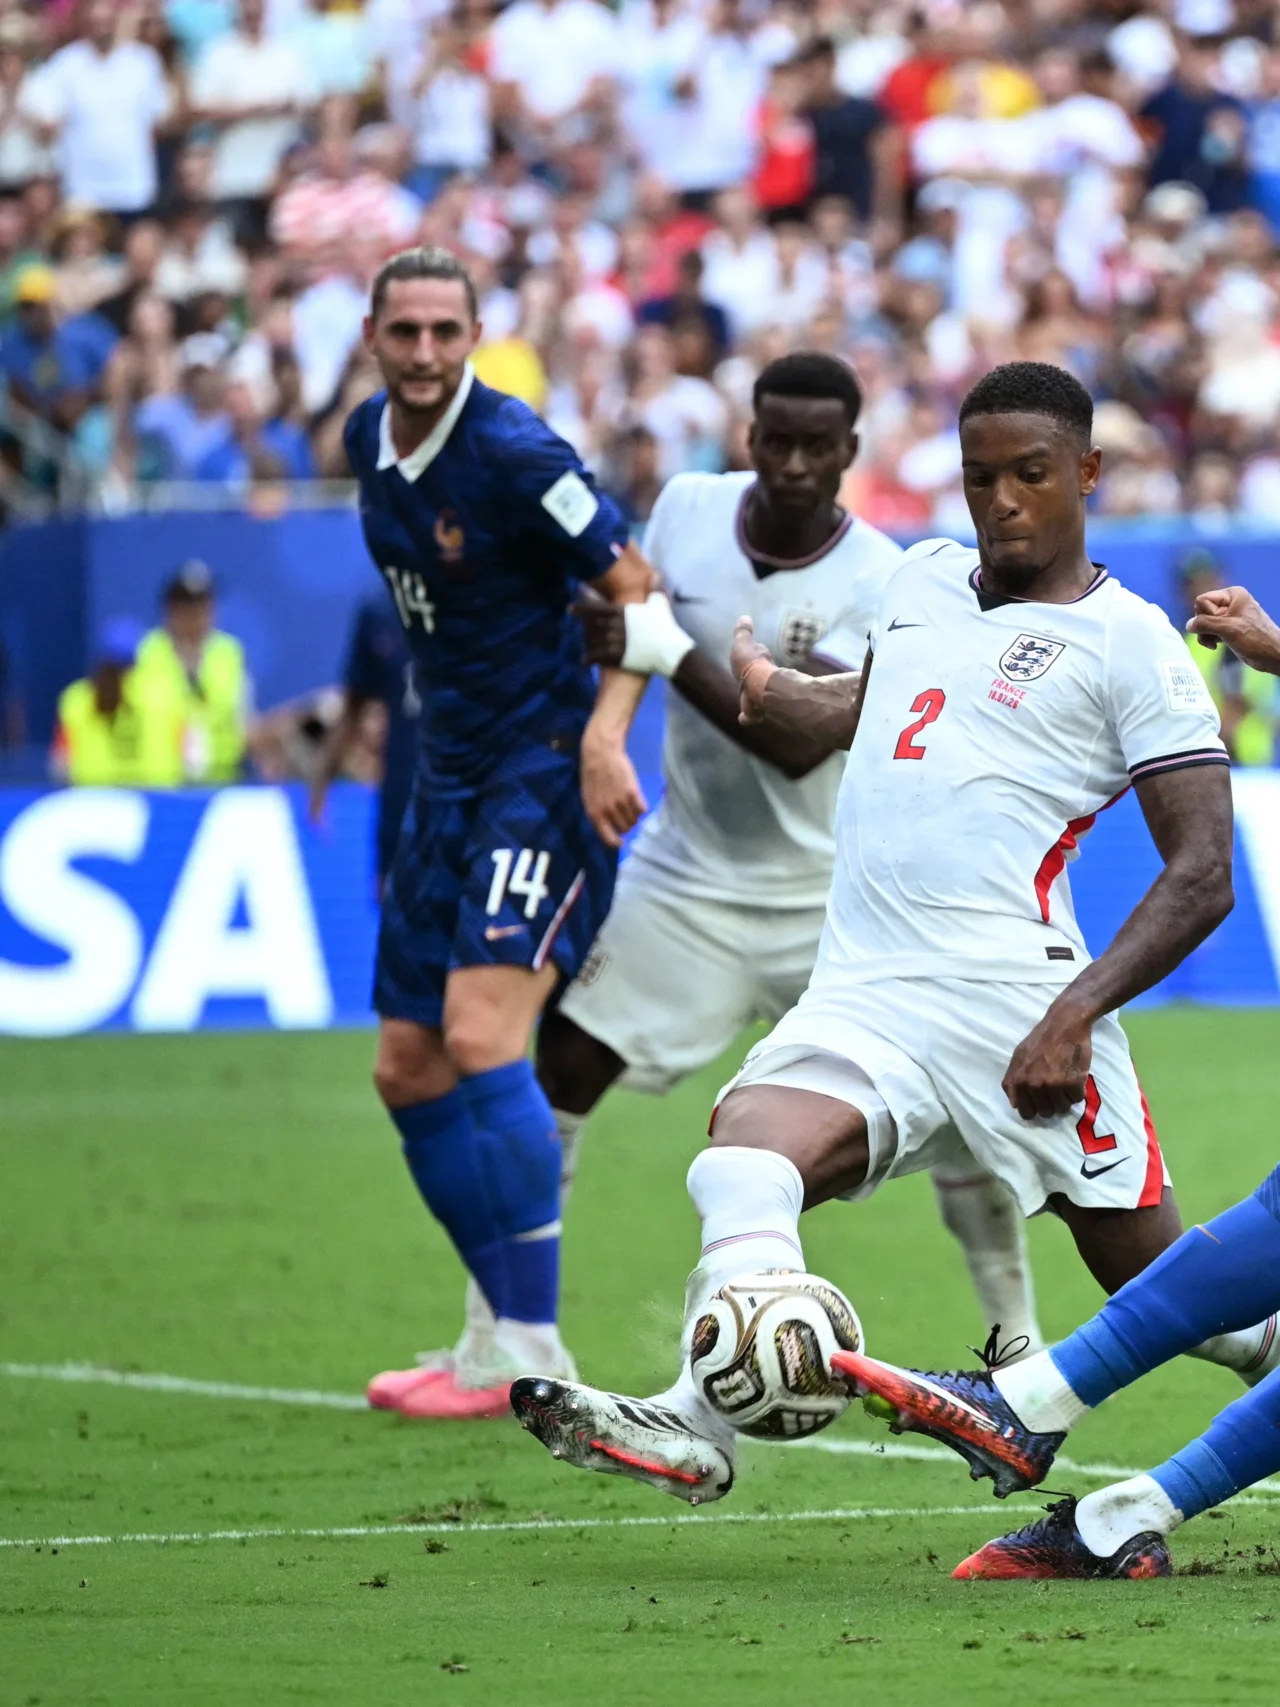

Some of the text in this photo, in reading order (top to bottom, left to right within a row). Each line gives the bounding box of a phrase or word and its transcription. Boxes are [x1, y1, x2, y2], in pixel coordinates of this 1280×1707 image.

[384, 565, 436, 634] 14
[893, 688, 946, 760] 2
[991, 678, 1026, 700] FRANCE
[486, 848, 550, 919] 14
[1076, 1073, 1117, 1155] 2
